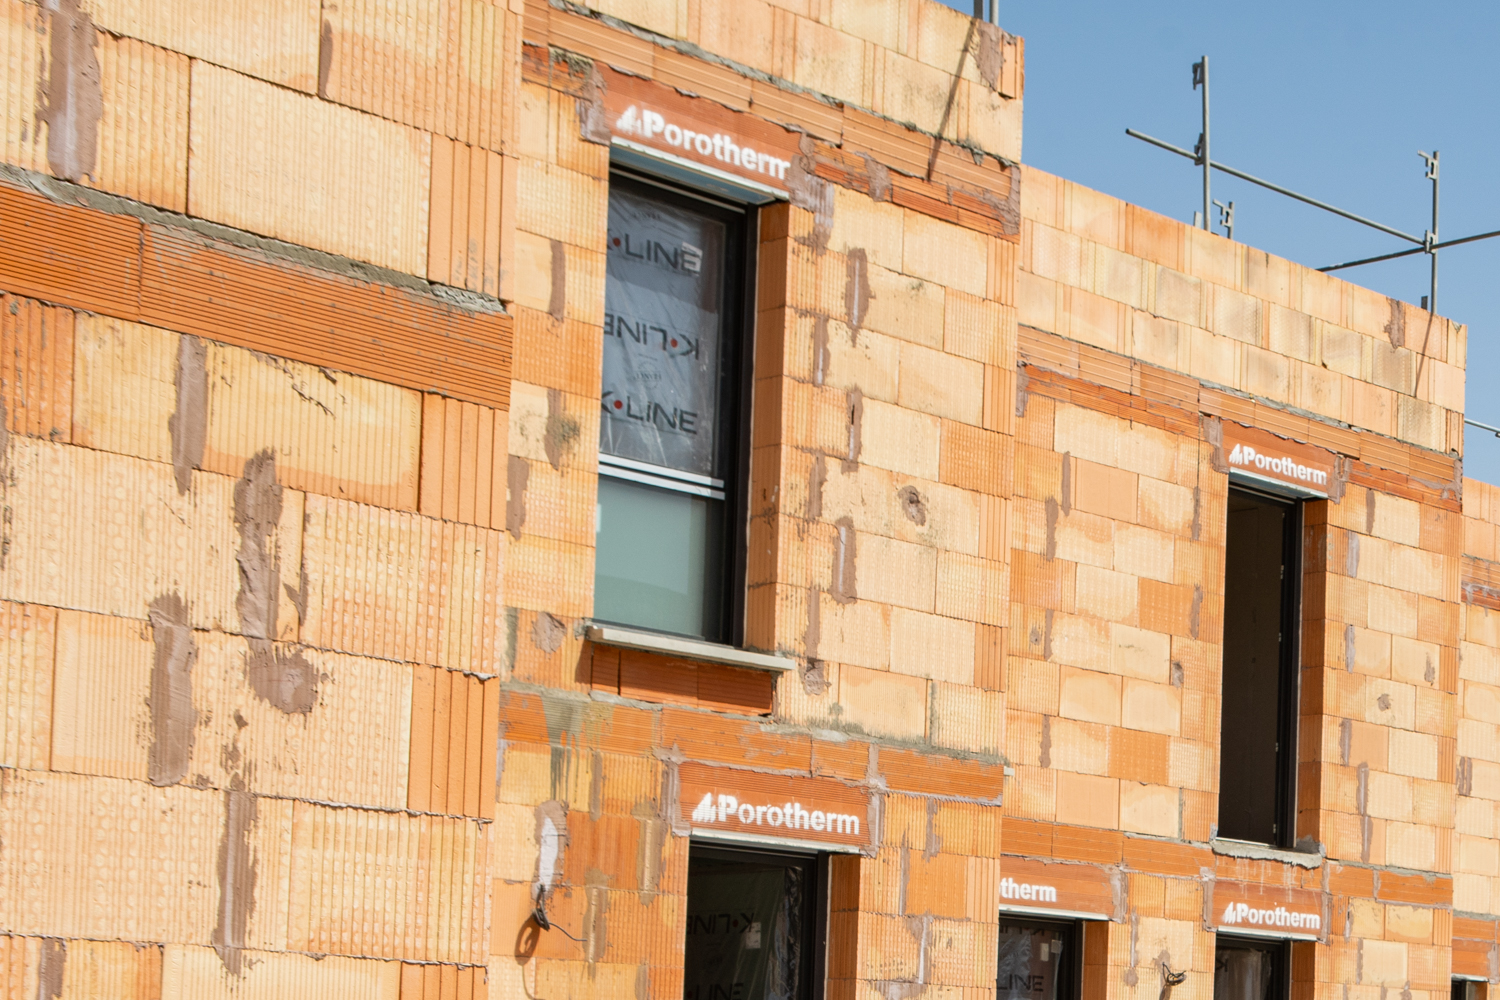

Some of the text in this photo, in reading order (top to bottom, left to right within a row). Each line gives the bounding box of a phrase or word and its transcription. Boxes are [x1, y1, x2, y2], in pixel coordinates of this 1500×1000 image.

[1242, 445, 1328, 486] Porotherm
[717, 793, 860, 835] Porotherm
[998, 877, 1058, 903] therm
[1236, 902, 1320, 930] Porotherm
